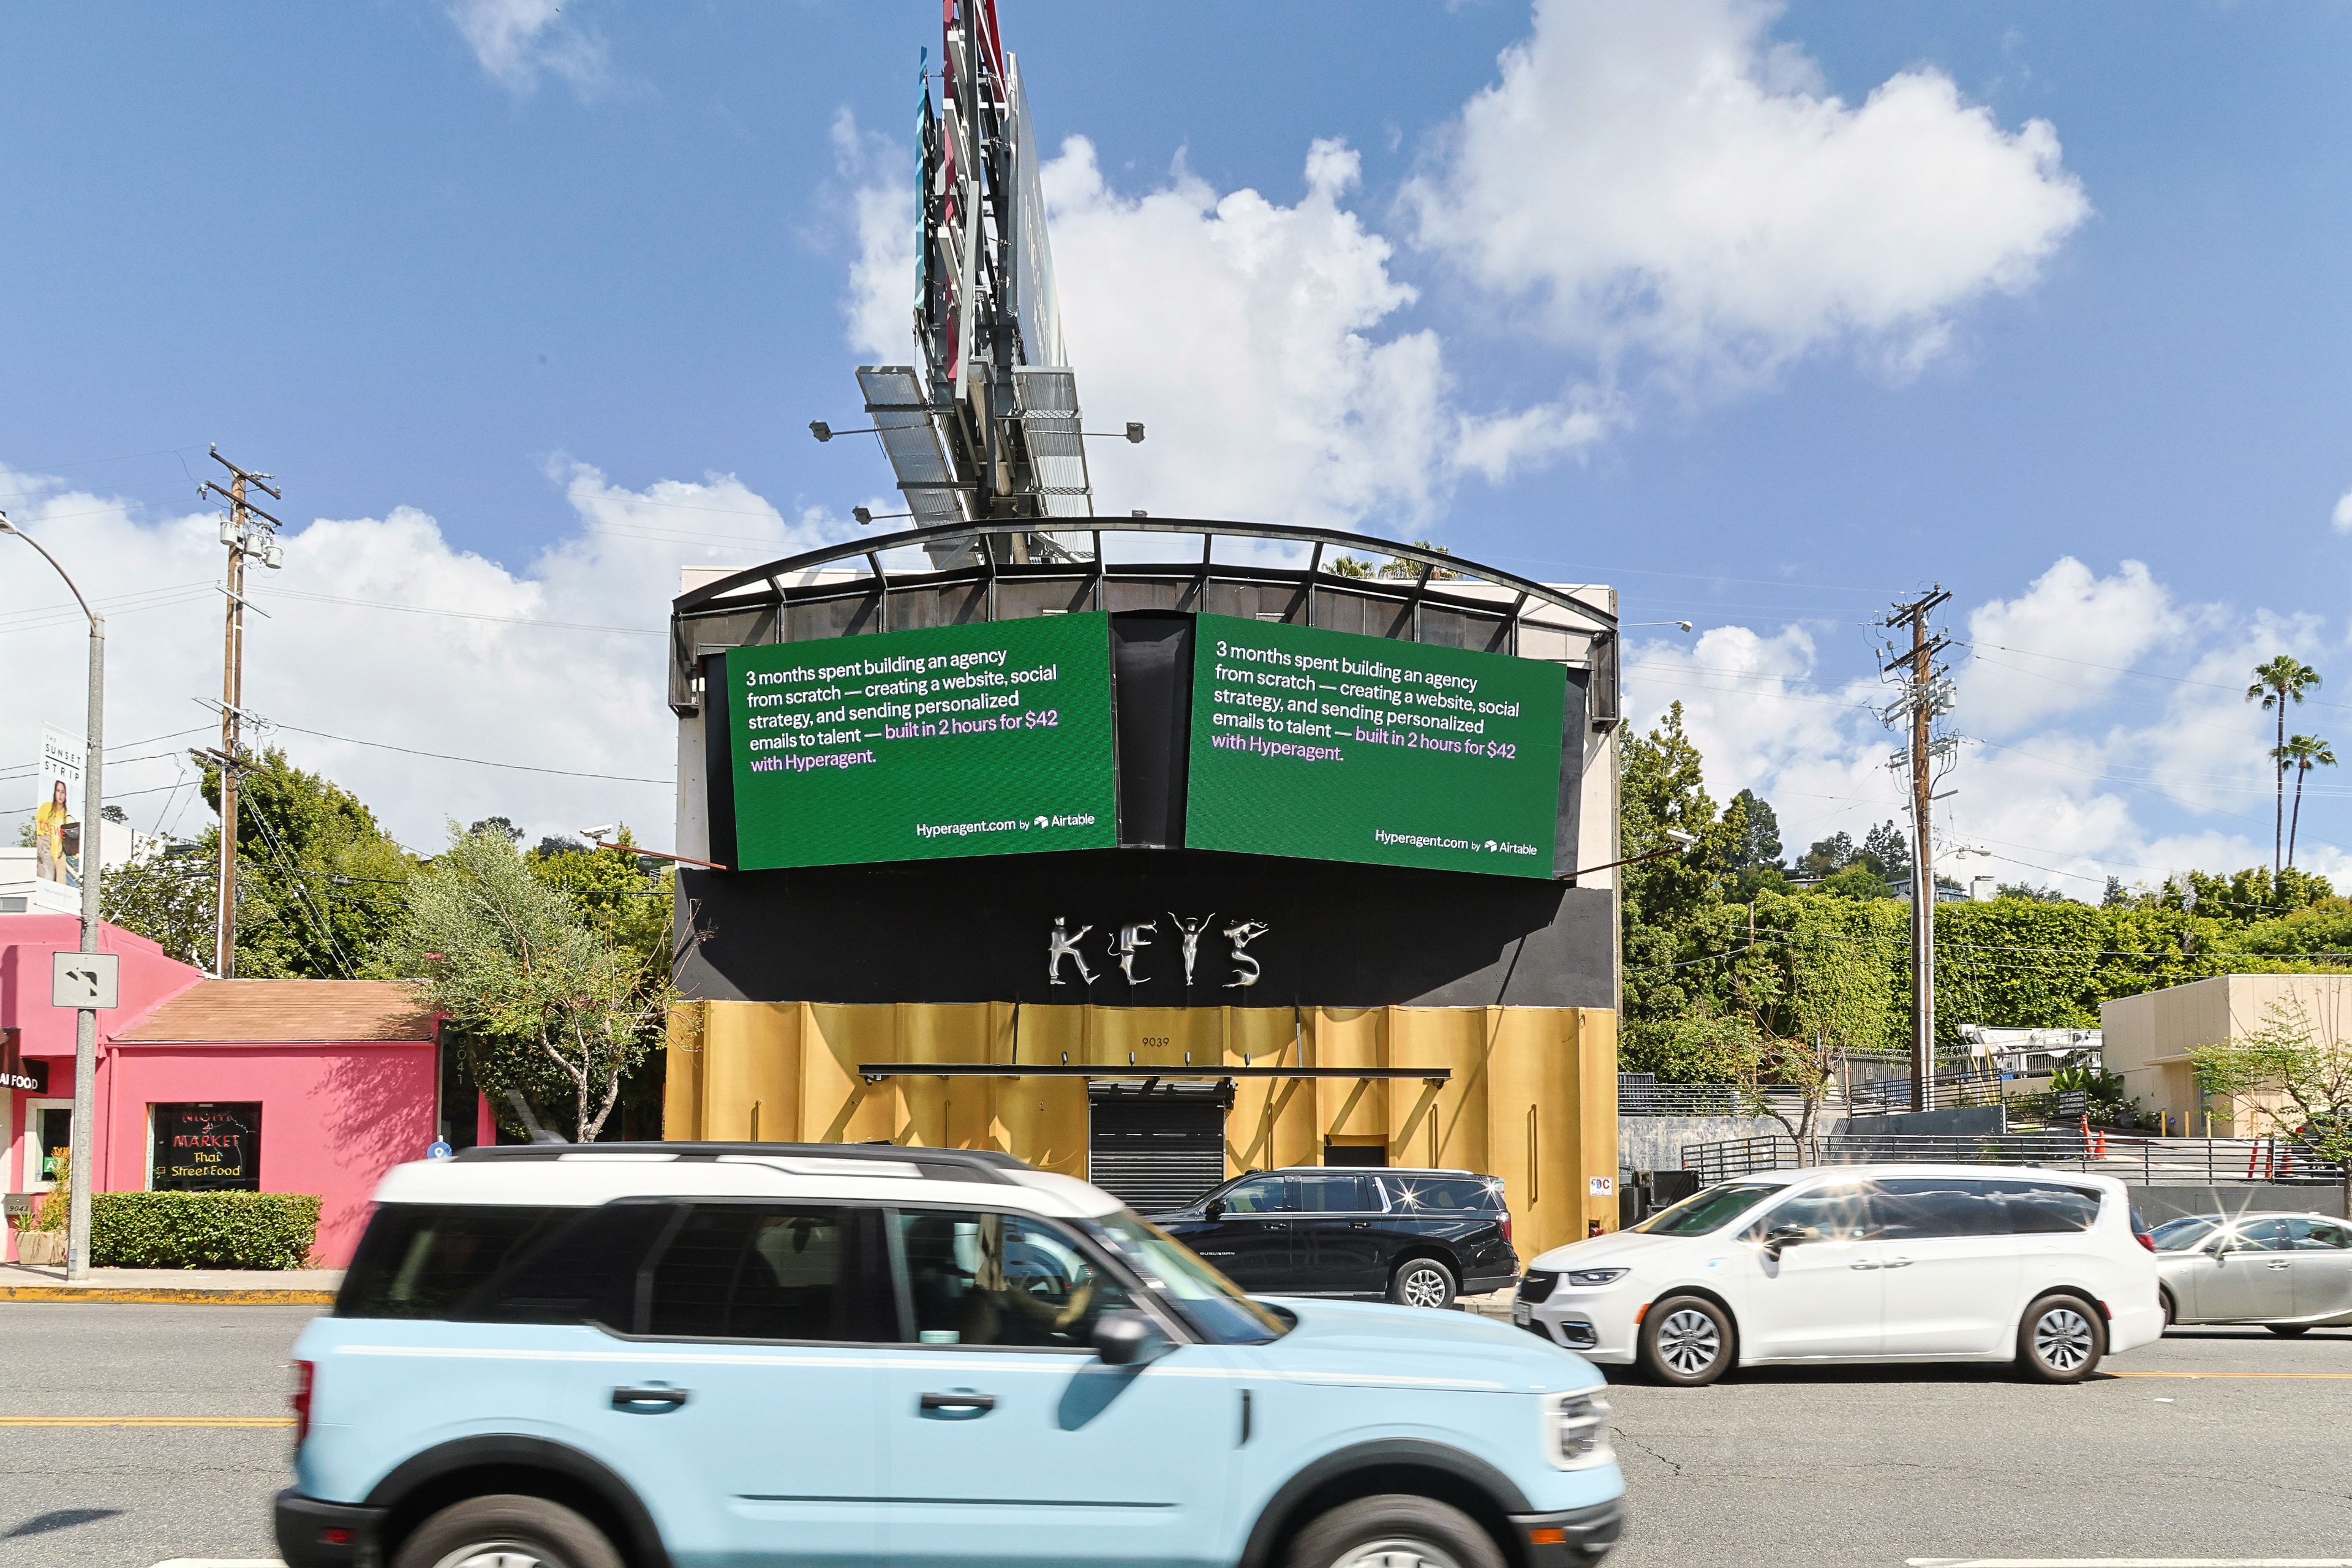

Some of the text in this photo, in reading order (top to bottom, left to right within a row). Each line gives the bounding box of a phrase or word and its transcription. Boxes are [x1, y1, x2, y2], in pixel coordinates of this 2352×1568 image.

[746, 650, 1007, 687] 3 months spent building an agency
[1216, 640, 1478, 694] 3 months spent building an agency
[747, 692, 783, 708] from
[785, 684, 841, 705] scratch
[865, 677, 929, 698] creating
[930, 679, 940, 692] a
[941, 670, 1008, 690] website,
[1011, 663, 1057, 684] social
[1215, 663, 1254, 684] from
[1256, 673, 1316, 692] scratch
[1340, 684, 1402, 706] creating
[1404, 692, 1413, 704] a
[1415, 692, 1476, 714] website,
[1478, 701, 1520, 717] social
[748, 690, 1019, 729] strategy, and sending personalized
[1214, 689, 1484, 734] strategy, and sending personalized
[750, 733, 797, 751] emails
[799, 733, 815, 747] to
[816, 728, 862, 745] talent
[885, 722, 919, 739] built
[921, 720, 936, 737] in
[938, 719, 949, 736] 2
[951, 718, 997, 734] hours
[999, 714, 1023, 729] for
[1025, 709, 1058, 729] $42
[1213, 712, 1265, 730] emails
[1267, 717, 1284, 733] to
[1286, 719, 1332, 739] talent
[1355, 725, 1389, 744] built
[1391, 729, 1405, 746] in
[1407, 732, 1418, 748] 2
[1420, 733, 1462, 753] hours
[1464, 738, 1485, 755] for
[1487, 740, 1517, 759] $42
[45, 744, 80, 764] SUNSET
[750, 749, 876, 772] with Hyperagent.
[1211, 733, 1344, 762] with Hyperagent.
[45, 761, 80, 781] STRIP
[39, 820, 66, 839] LOEWE
[916, 812, 1095, 839] Hyperagent.com by Airtable
[1375, 829, 1537, 856] Hyperagent.com by Airtable
[1048, 911, 1269, 987] KEYS
[1142, 1037, 1169, 1047] 9039
[456, 1037, 467, 1085] 9041
[11, 1075, 38, 1090] FOOD
[173, 1135, 240, 1147] MARKET
[172, 1166, 241, 1177] Street Food
[194, 1152, 221, 1163] Thai
